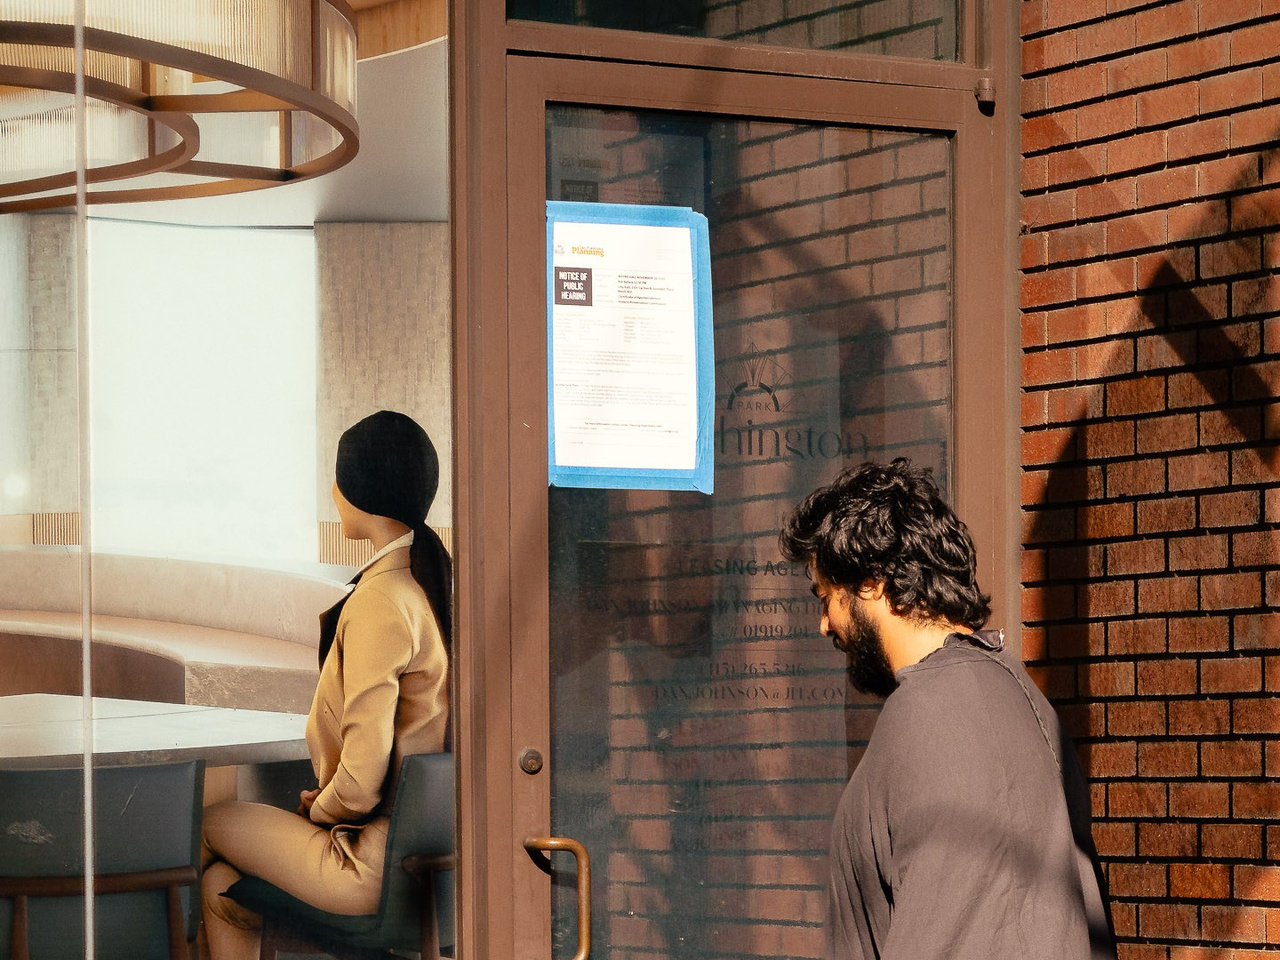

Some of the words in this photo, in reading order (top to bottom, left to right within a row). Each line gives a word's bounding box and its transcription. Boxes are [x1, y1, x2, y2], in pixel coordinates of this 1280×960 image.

[571, 246, 605, 258] Planning
[559, 271, 580, 281] NOTICE
[580, 272, 588, 281] OF
[563, 281, 584, 291] PUBLIC
[561, 291, 587, 301] HEARING
[737, 401, 772, 412] PARK
[719, 415, 869, 467] hington
[764, 560, 800, 577] AGE
